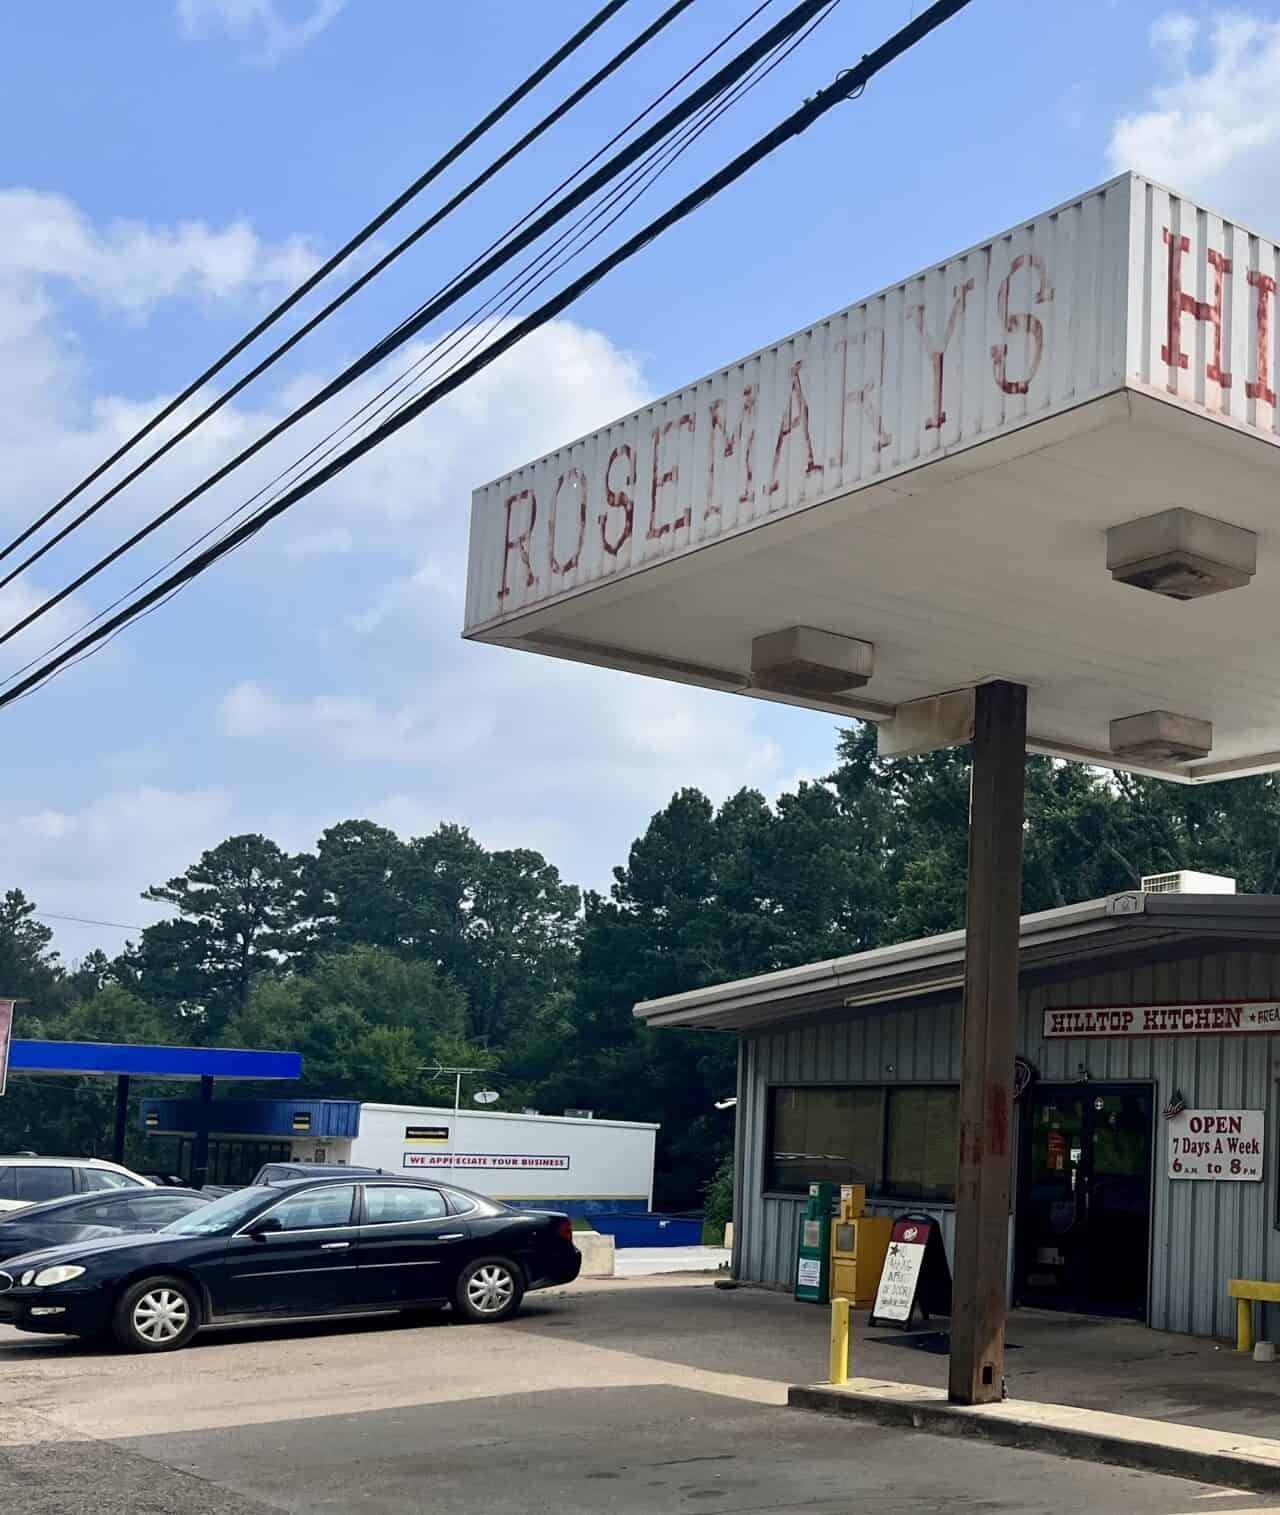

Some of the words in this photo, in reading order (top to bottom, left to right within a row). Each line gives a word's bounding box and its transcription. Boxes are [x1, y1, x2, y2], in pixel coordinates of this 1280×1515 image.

[1050, 1011, 1134, 1033] HILLTOP
[1143, 1007, 1243, 1031] KITCHEN
[1189, 1116, 1243, 1134] OPEN
[1172, 1137, 1180, 1155] 7
[1182, 1137, 1211, 1158] Days
[1213, 1137, 1224, 1154] A
[1227, 1137, 1261, 1155] Week
[410, 1156, 425, 1165] WE
[491, 1158, 518, 1166] YOUR
[521, 1159, 564, 1167] BUSINESS
[1172, 1158, 1183, 1173] 6
[1207, 1163, 1222, 1174] to
[1230, 1159, 1242, 1175] 8
